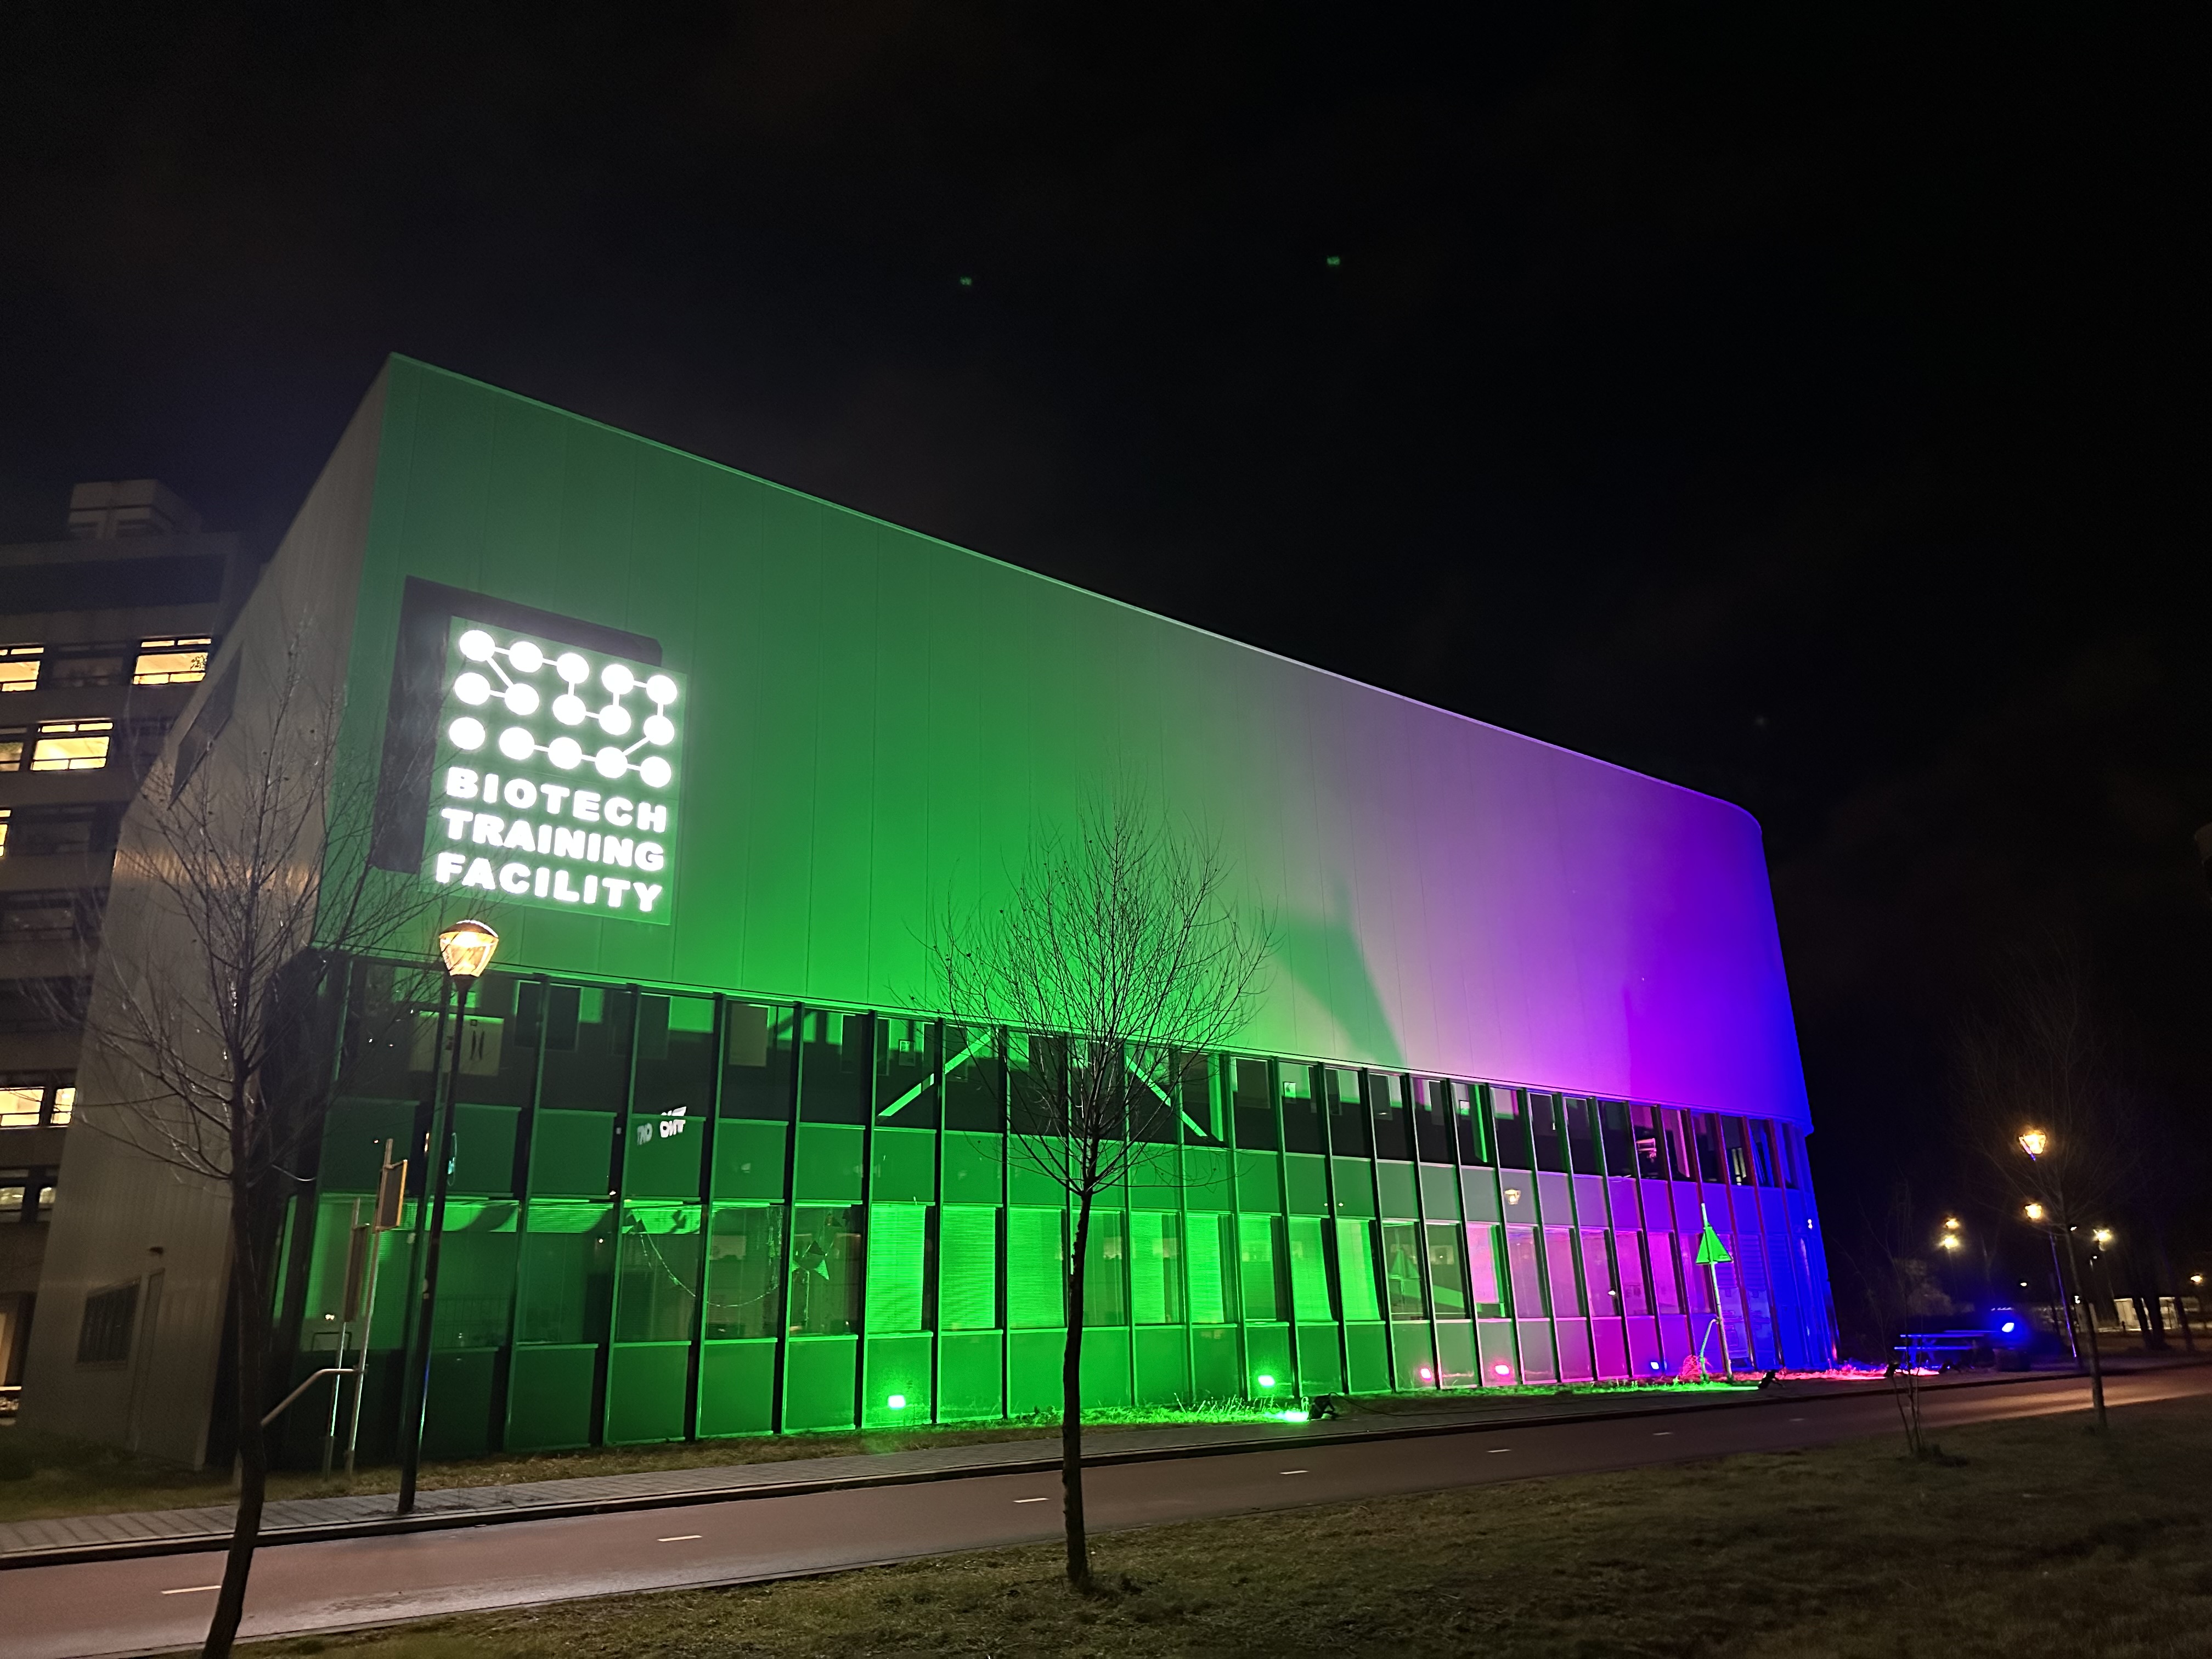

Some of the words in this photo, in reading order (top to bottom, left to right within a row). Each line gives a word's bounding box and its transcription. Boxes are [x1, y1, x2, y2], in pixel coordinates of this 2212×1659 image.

[445, 766, 667, 833] BIOTECH
[441, 807, 664, 872] TRAINING
[435, 851, 663, 912] FACILITY
